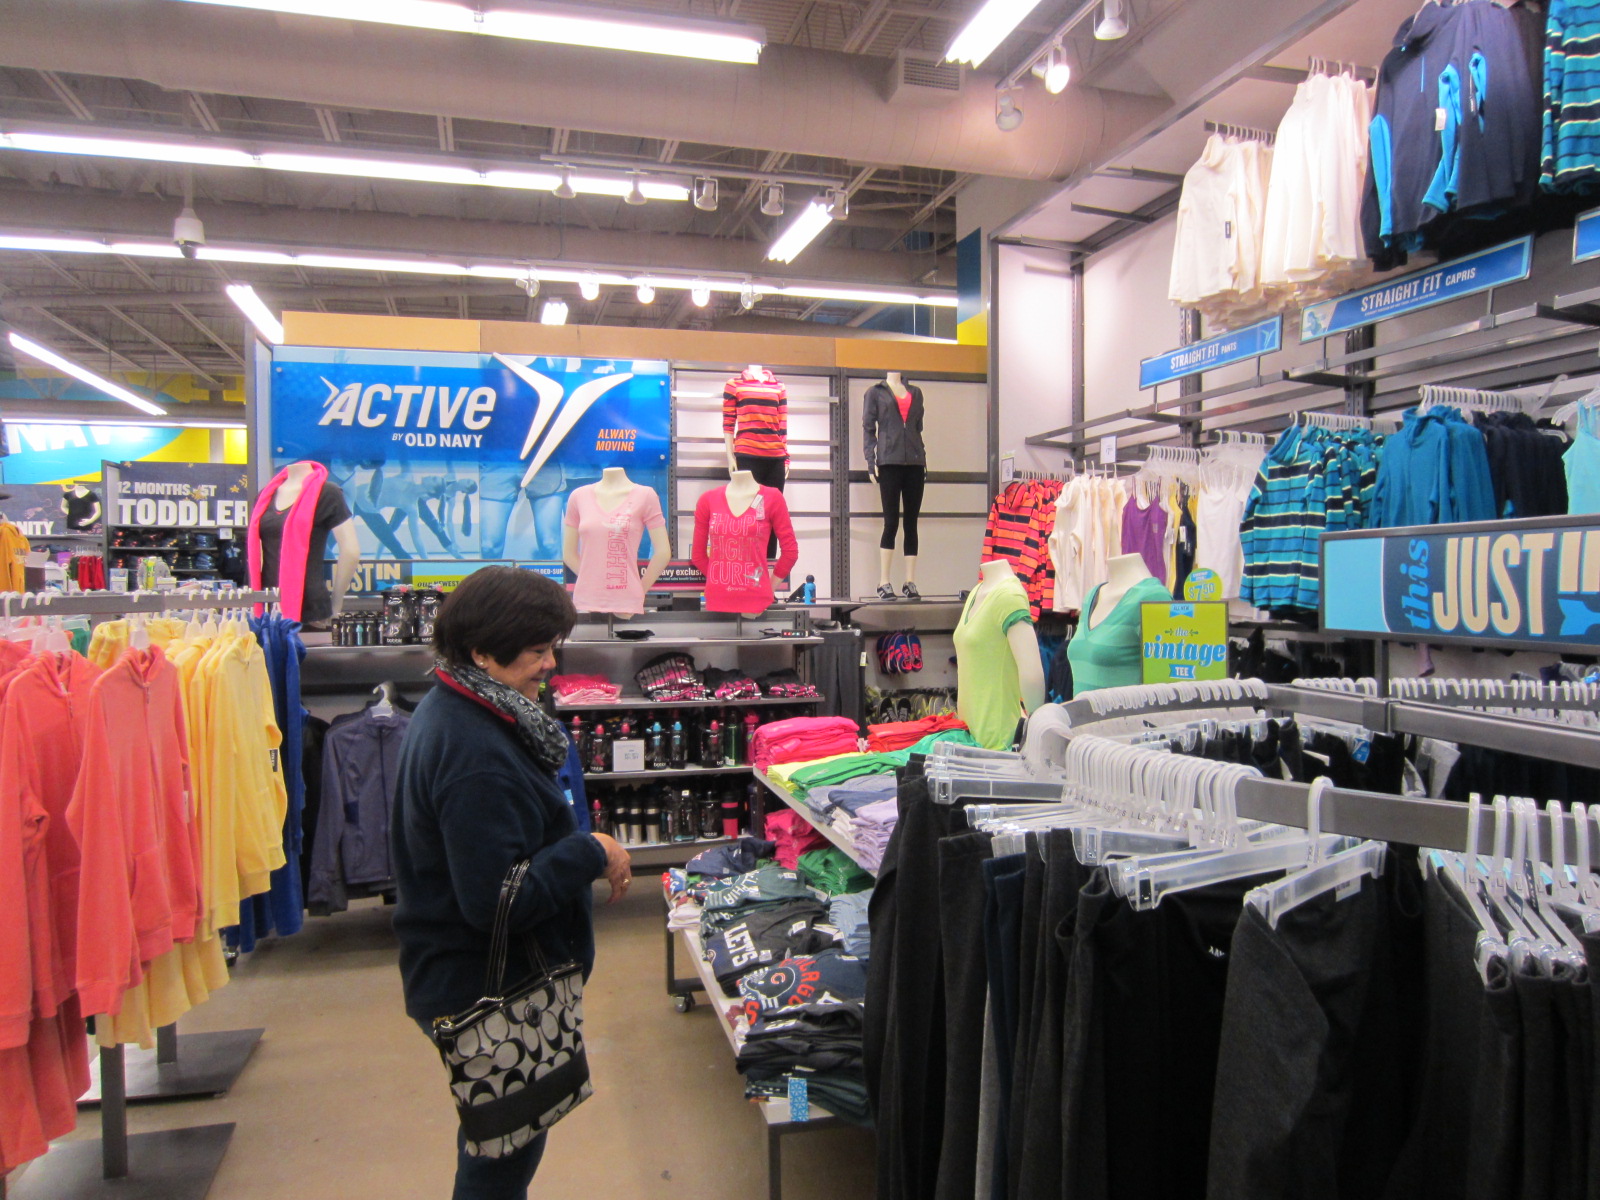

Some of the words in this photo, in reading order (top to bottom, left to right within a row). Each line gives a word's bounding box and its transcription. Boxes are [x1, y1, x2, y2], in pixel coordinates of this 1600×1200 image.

[1361, 280, 1421, 312] STRAIGHT
[1422, 272, 1443, 294] FIT
[1445, 267, 1476, 286] CAPRIS
[1170, 347, 1206, 370] STRAIGHT
[1207, 343, 1220, 359] FIT
[1221, 342, 1237, 354] PANTS
[392, 432, 403, 441] BY
[404, 433, 437, 448] OLD
[439, 434, 483, 448] NAVY
[597, 429, 637, 440] ALWAYS
[595, 440, 635, 452] MOVING
[117, 481, 131, 494] 12
[134, 482, 191, 496] MONTHS
[715, 513, 765, 537] HOPE
[376, 562, 401, 580] IN
[709, 560, 756, 586] CURE
[1400, 538, 1431, 630] this
[1432, 532, 1555, 637] JUST
[1174, 627, 1190, 637] the
[1143, 634, 1227, 667] vintage
[1175, 667, 1190, 677] TEE
